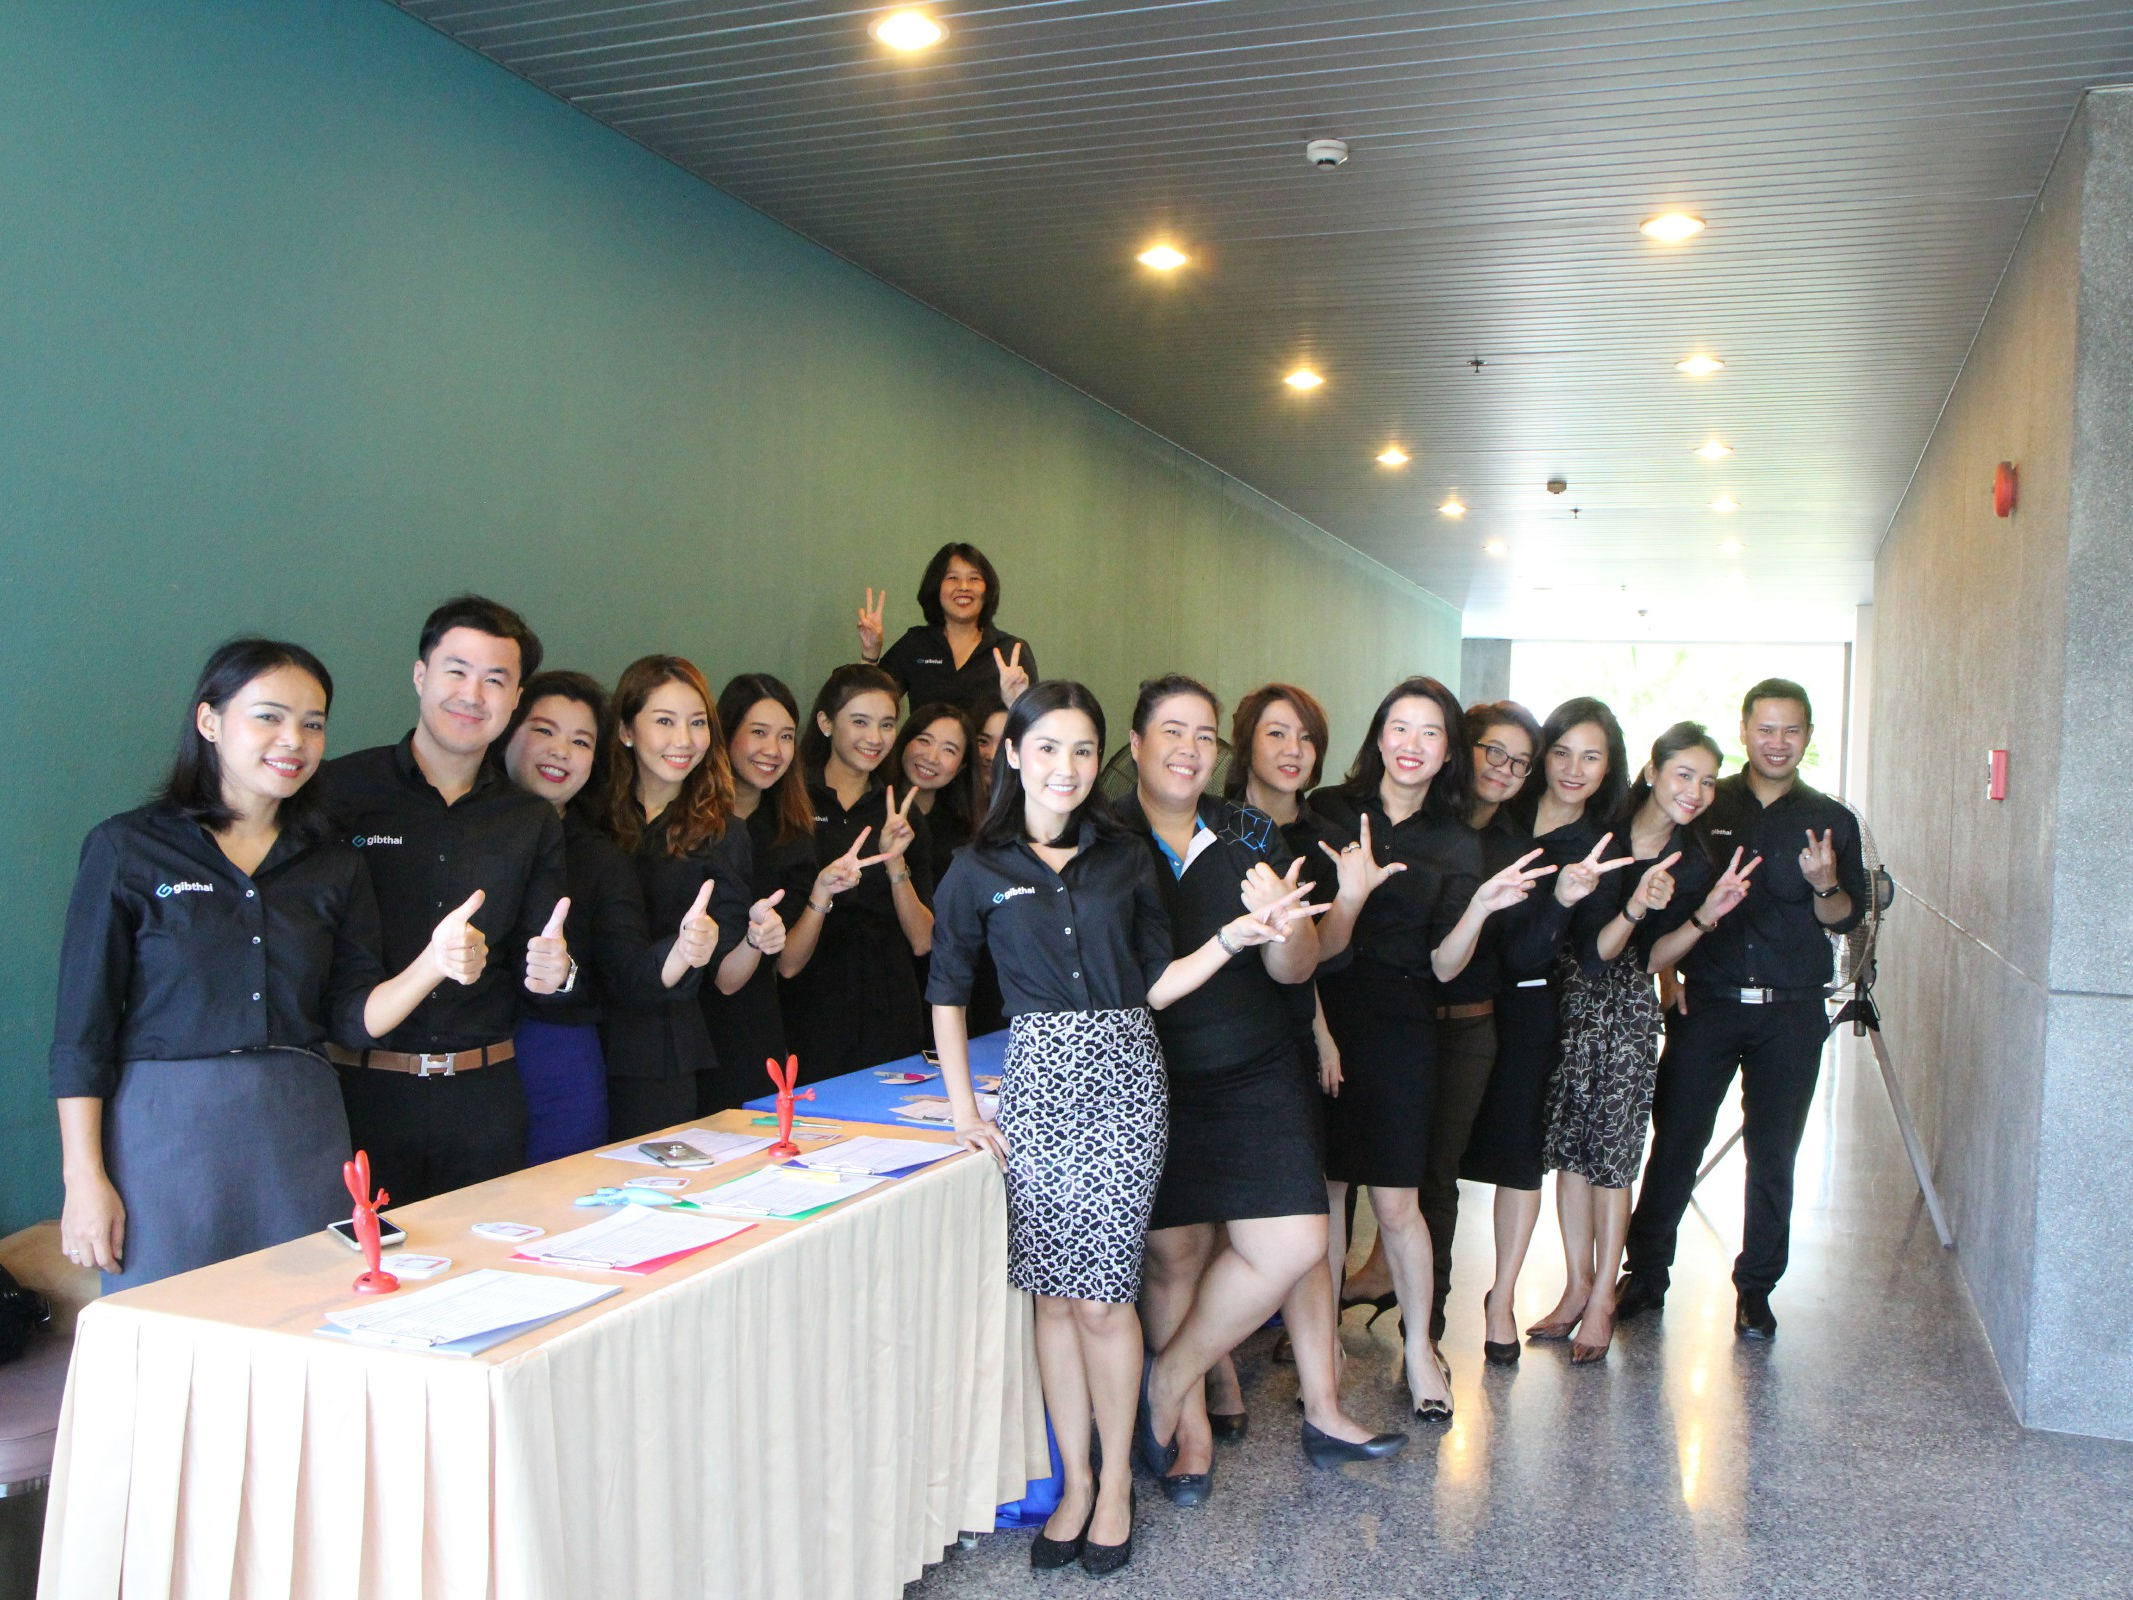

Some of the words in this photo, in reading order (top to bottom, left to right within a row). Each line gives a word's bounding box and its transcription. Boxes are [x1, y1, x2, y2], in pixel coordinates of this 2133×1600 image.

[366, 834, 403, 846] gibthai
[173, 881, 214, 894] gibthai
[1004, 886, 1035, 900] gibthai
